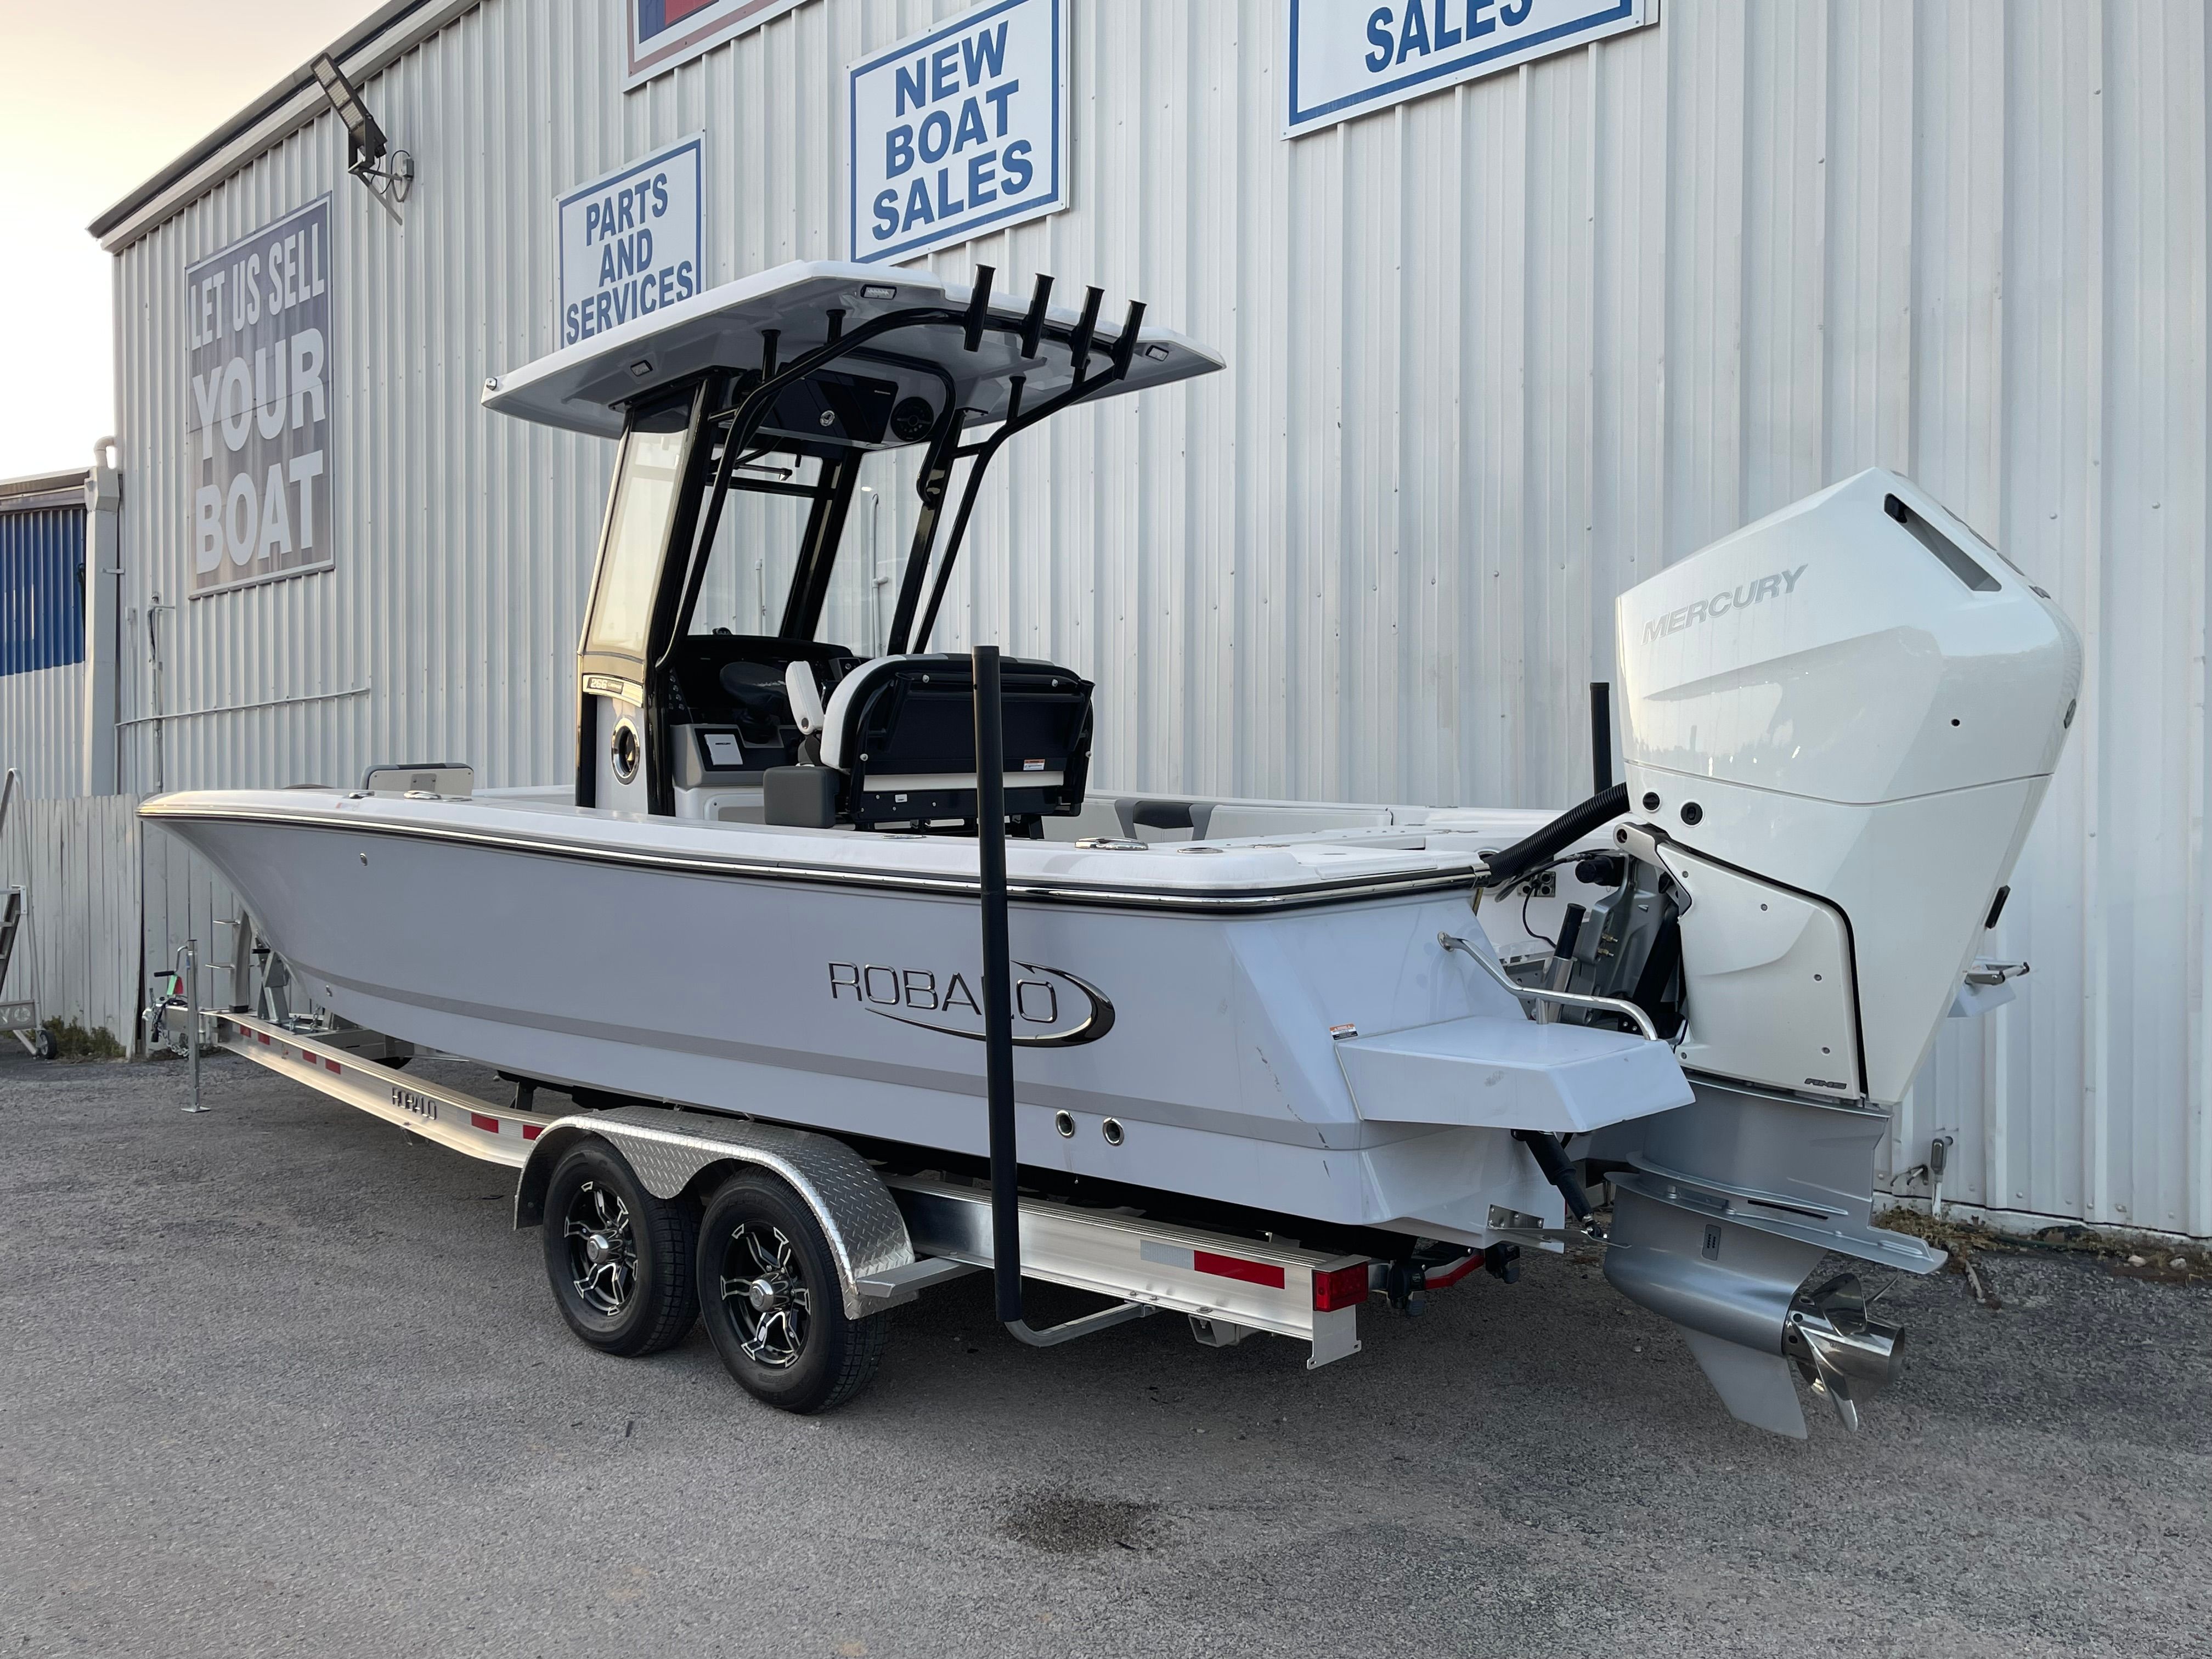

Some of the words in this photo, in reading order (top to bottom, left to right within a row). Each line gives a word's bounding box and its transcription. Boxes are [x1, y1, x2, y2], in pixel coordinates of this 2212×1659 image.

[895, 20, 1009, 118] NEW
[886, 79, 1019, 180] BOAT
[586, 173, 668, 246] PARTS
[872, 139, 1032, 240] SALES
[191, 270, 225, 351] LET
[233, 253, 260, 331] US
[269, 223, 325, 315] SELL
[566, 261, 693, 345] SERVICES
[599, 228, 653, 287] AND
[193, 328, 326, 460] YOUR
[196, 449, 324, 574] BOAT
[1641, 563, 1809, 646] MERCURY
[828, 961, 1058, 1024] ROBAO
